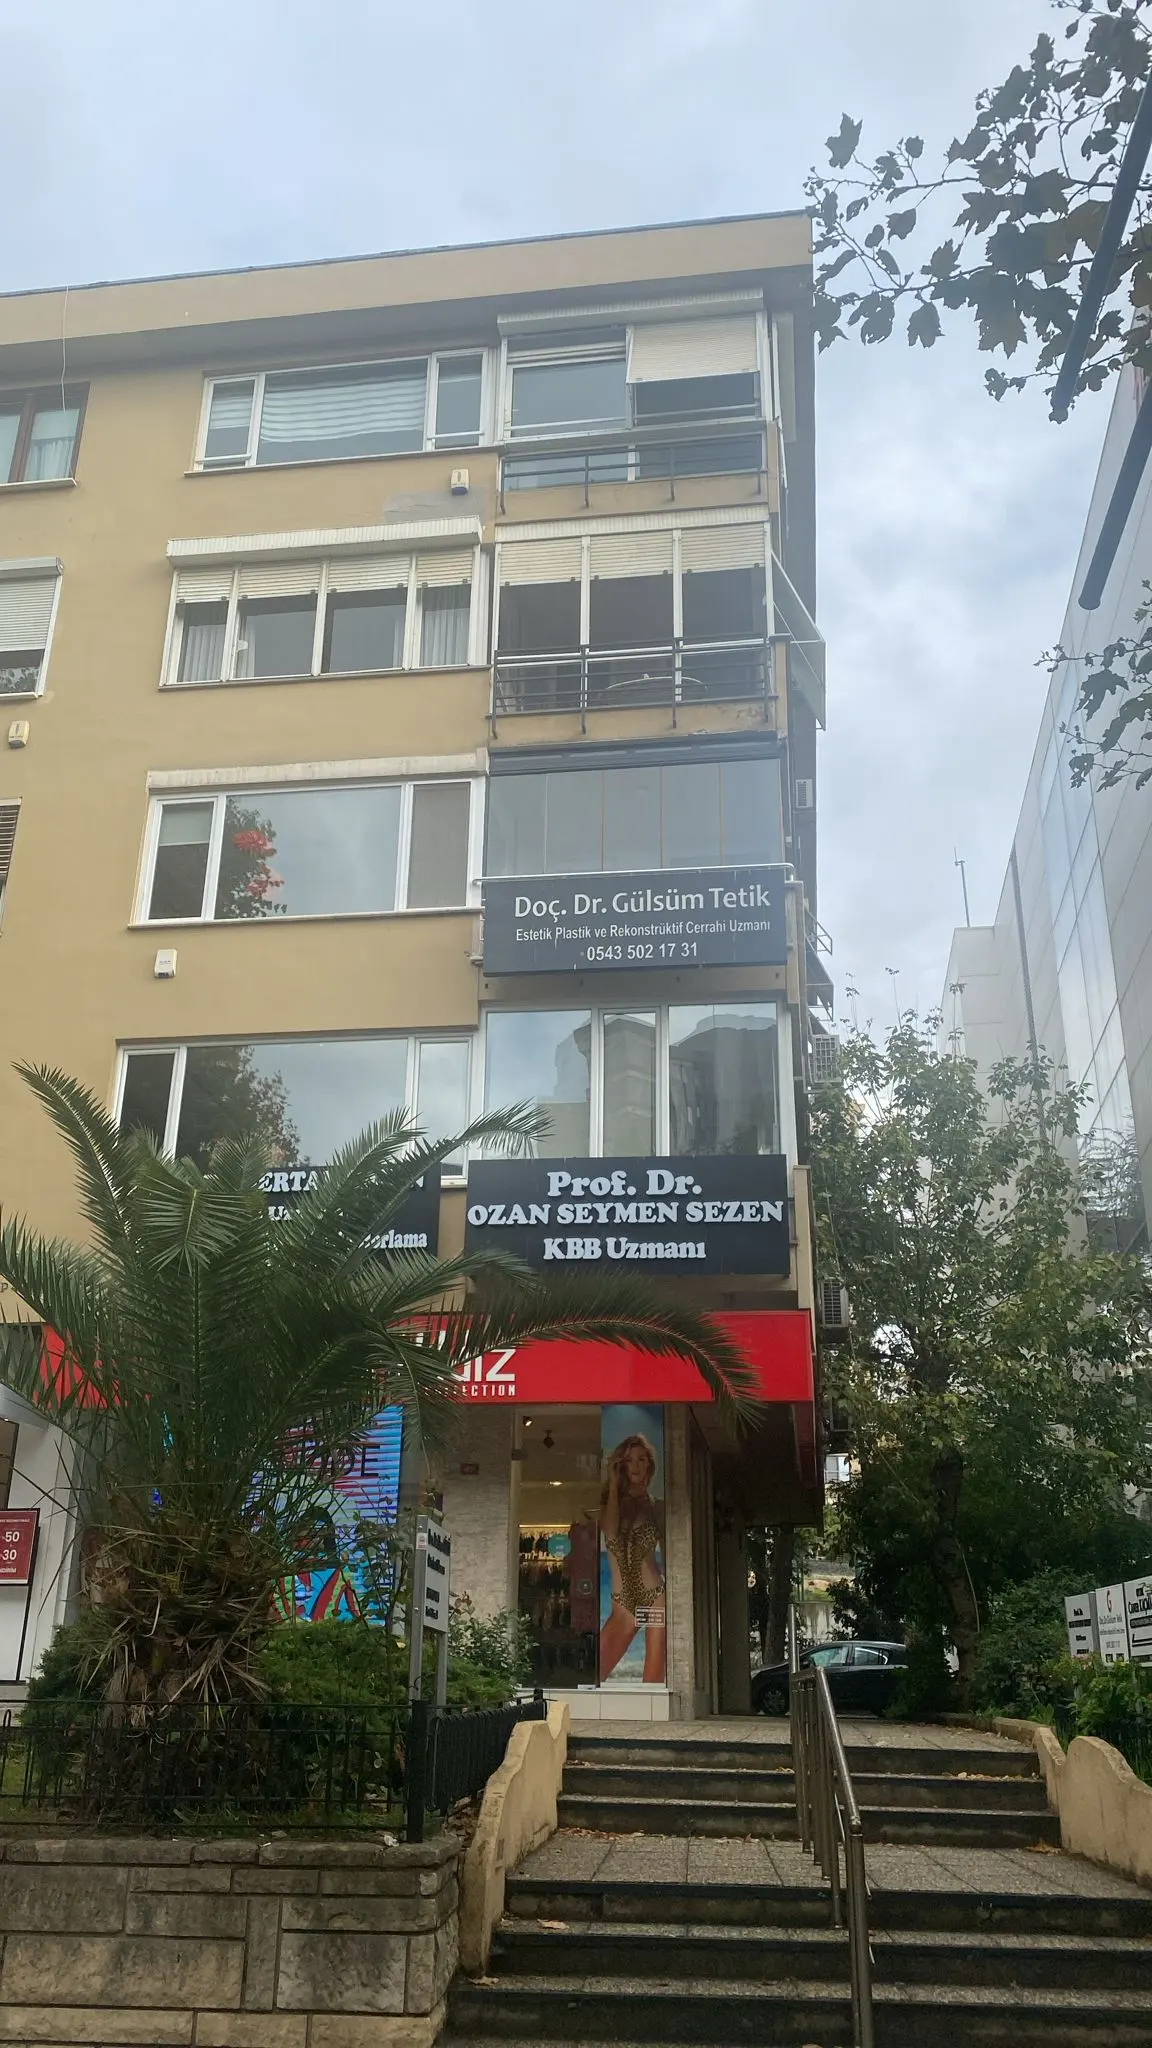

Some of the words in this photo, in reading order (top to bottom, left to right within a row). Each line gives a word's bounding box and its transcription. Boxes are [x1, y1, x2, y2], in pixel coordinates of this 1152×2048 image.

[514, 896, 567, 924] Doç.
[574, 893, 608, 915] Dr.
[611, 888, 704, 914] Gülsüm
[708, 884, 771, 909] Tetik
[515, 926, 553, 942] Estetik
[554, 926, 592, 941] Plastik
[594, 927, 607, 938] ve
[610, 922, 684, 938] Rekonstrüktif
[685, 920, 727, 934] Cerrahi
[729, 919, 771, 933] Uzmanı
[586, 945, 623, 961] 0543
[627, 943, 654, 960] 502
[658, 943, 676, 958] 17
[680, 941, 698, 957] 31
[547, 1170, 636, 1197] Prof.
[646, 1169, 703, 1195] Dr.
[467, 1202, 551, 1226] OZAN
[556, 1201, 678, 1224] SEYMEN
[685, 1200, 784, 1223] SEZEN
[543, 1237, 602, 1260] KBB
[605, 1236, 706, 1259] Uzmanı
